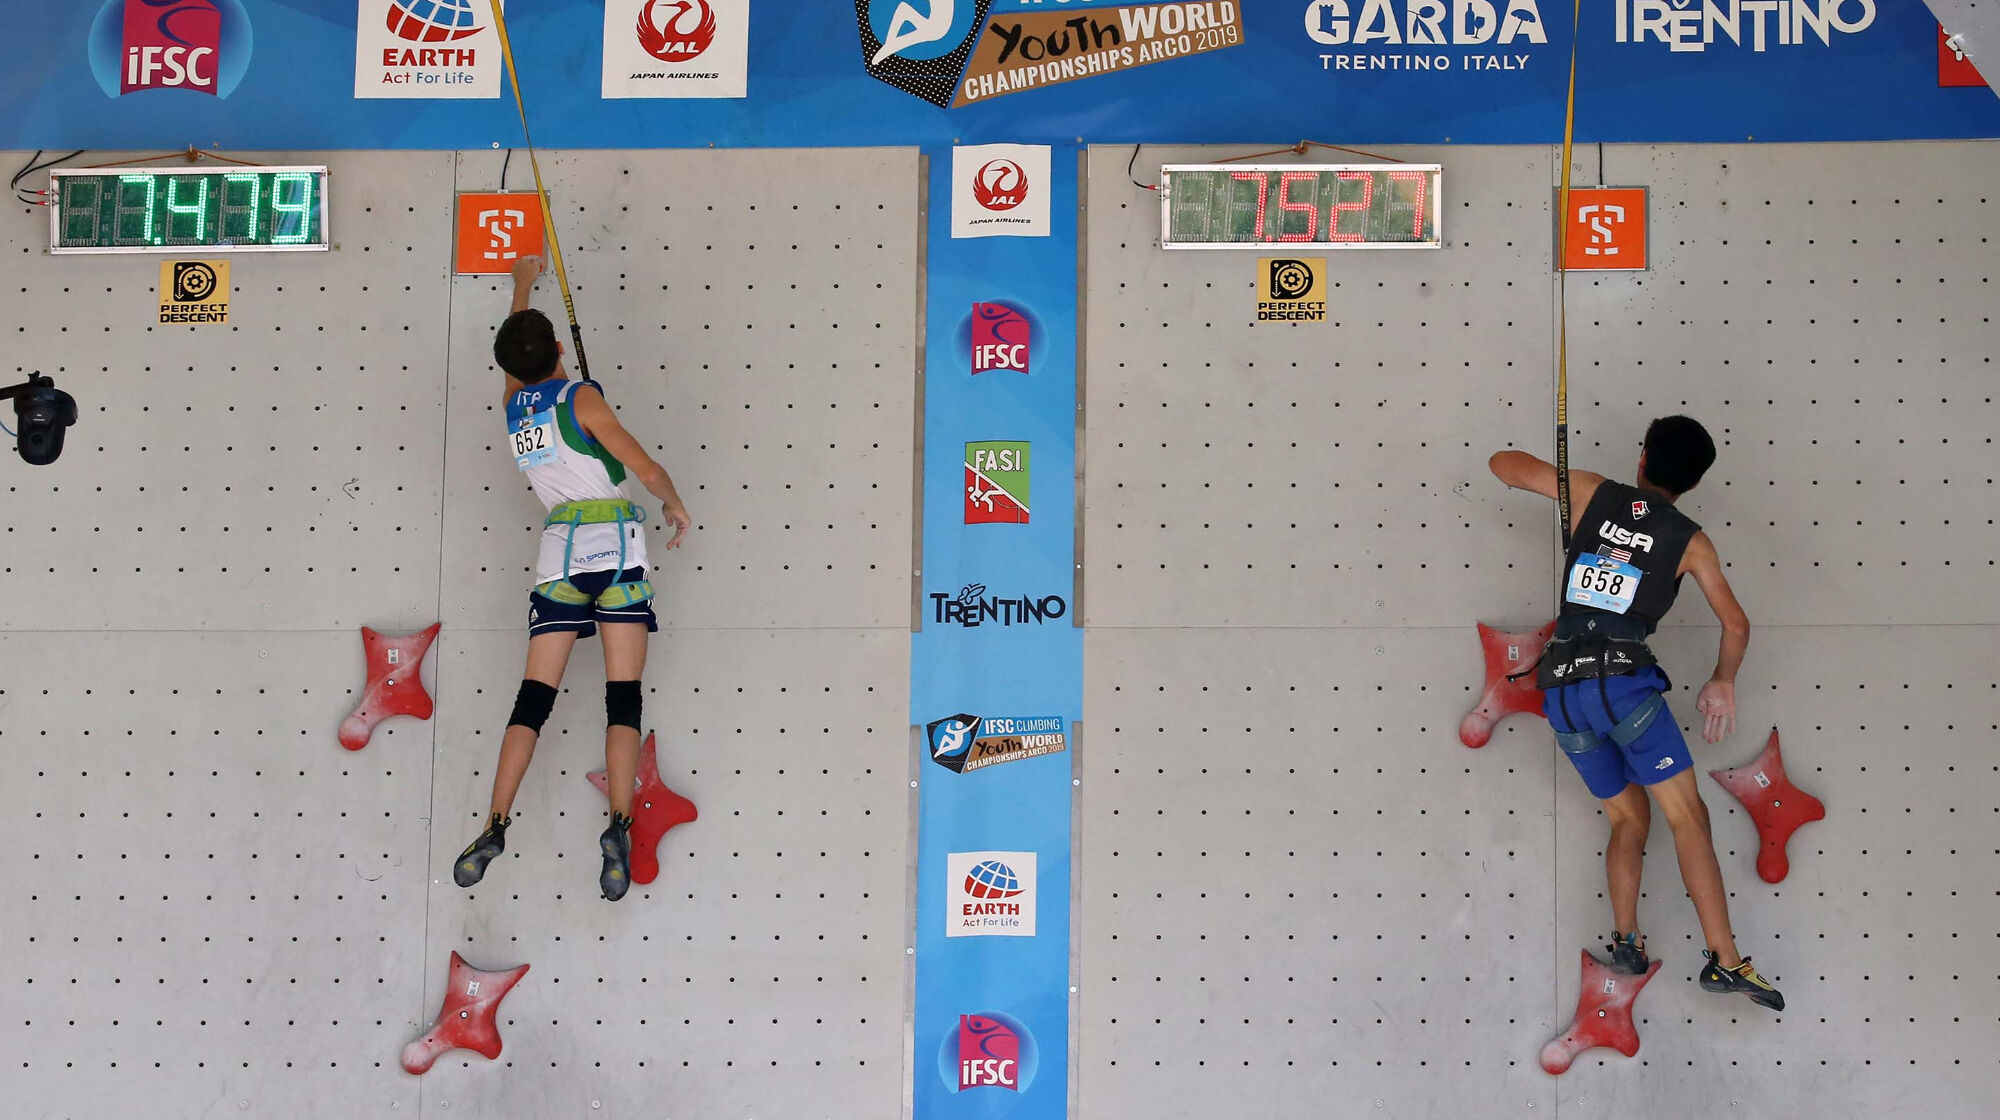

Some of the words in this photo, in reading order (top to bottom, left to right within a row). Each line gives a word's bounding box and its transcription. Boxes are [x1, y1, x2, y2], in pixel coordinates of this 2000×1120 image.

[1118, 1, 1235, 42] WORLD
[1304, 0, 1548, 45] GARDA
[656, 41, 700, 53] JAL
[382, 48, 475, 67] EARTH
[964, 46, 1134, 100] CHAMPIONSHIPS
[1139, 34, 1192, 63] ARCO
[1195, 24, 1238, 51] 2019
[1319, 54, 1450, 70] TRENTINO
[1463, 54, 1530, 70] ITALY
[382, 72, 411, 84] Act
[416, 72, 441, 84] For
[445, 72, 474, 84] Life
[118, 172, 313, 244] 7.479
[987, 196, 1017, 205] JAL
[1229, 171, 1426, 243] 7.527
[160, 304, 228, 313] PERFECT
[1258, 302, 1325, 311] PERFECT
[160, 312, 228, 323] DESCENT
[1257, 311, 1325, 321] DESCENT
[517, 391, 542, 406] ITA
[515, 427, 545, 455] 652
[1598, 520, 1653, 553] USA
[1581, 567, 1624, 595] 658
[929, 592, 1066, 628] TRENTINO
[985, 719, 1014, 734] IFSC
[1016, 718, 1060, 732] CLIMBING
[1021, 733, 1063, 750] WORLD
[966, 750, 1027, 771] CHAMPIONSHIPS
[1027, 746, 1048, 758] ARCO
[1048, 742, 1064, 754] 2019
[963, 903, 1020, 916] EARTH
[963, 919, 980, 927] Act
[983, 918, 999, 926] For
[1000, 918, 1019, 927] Life
